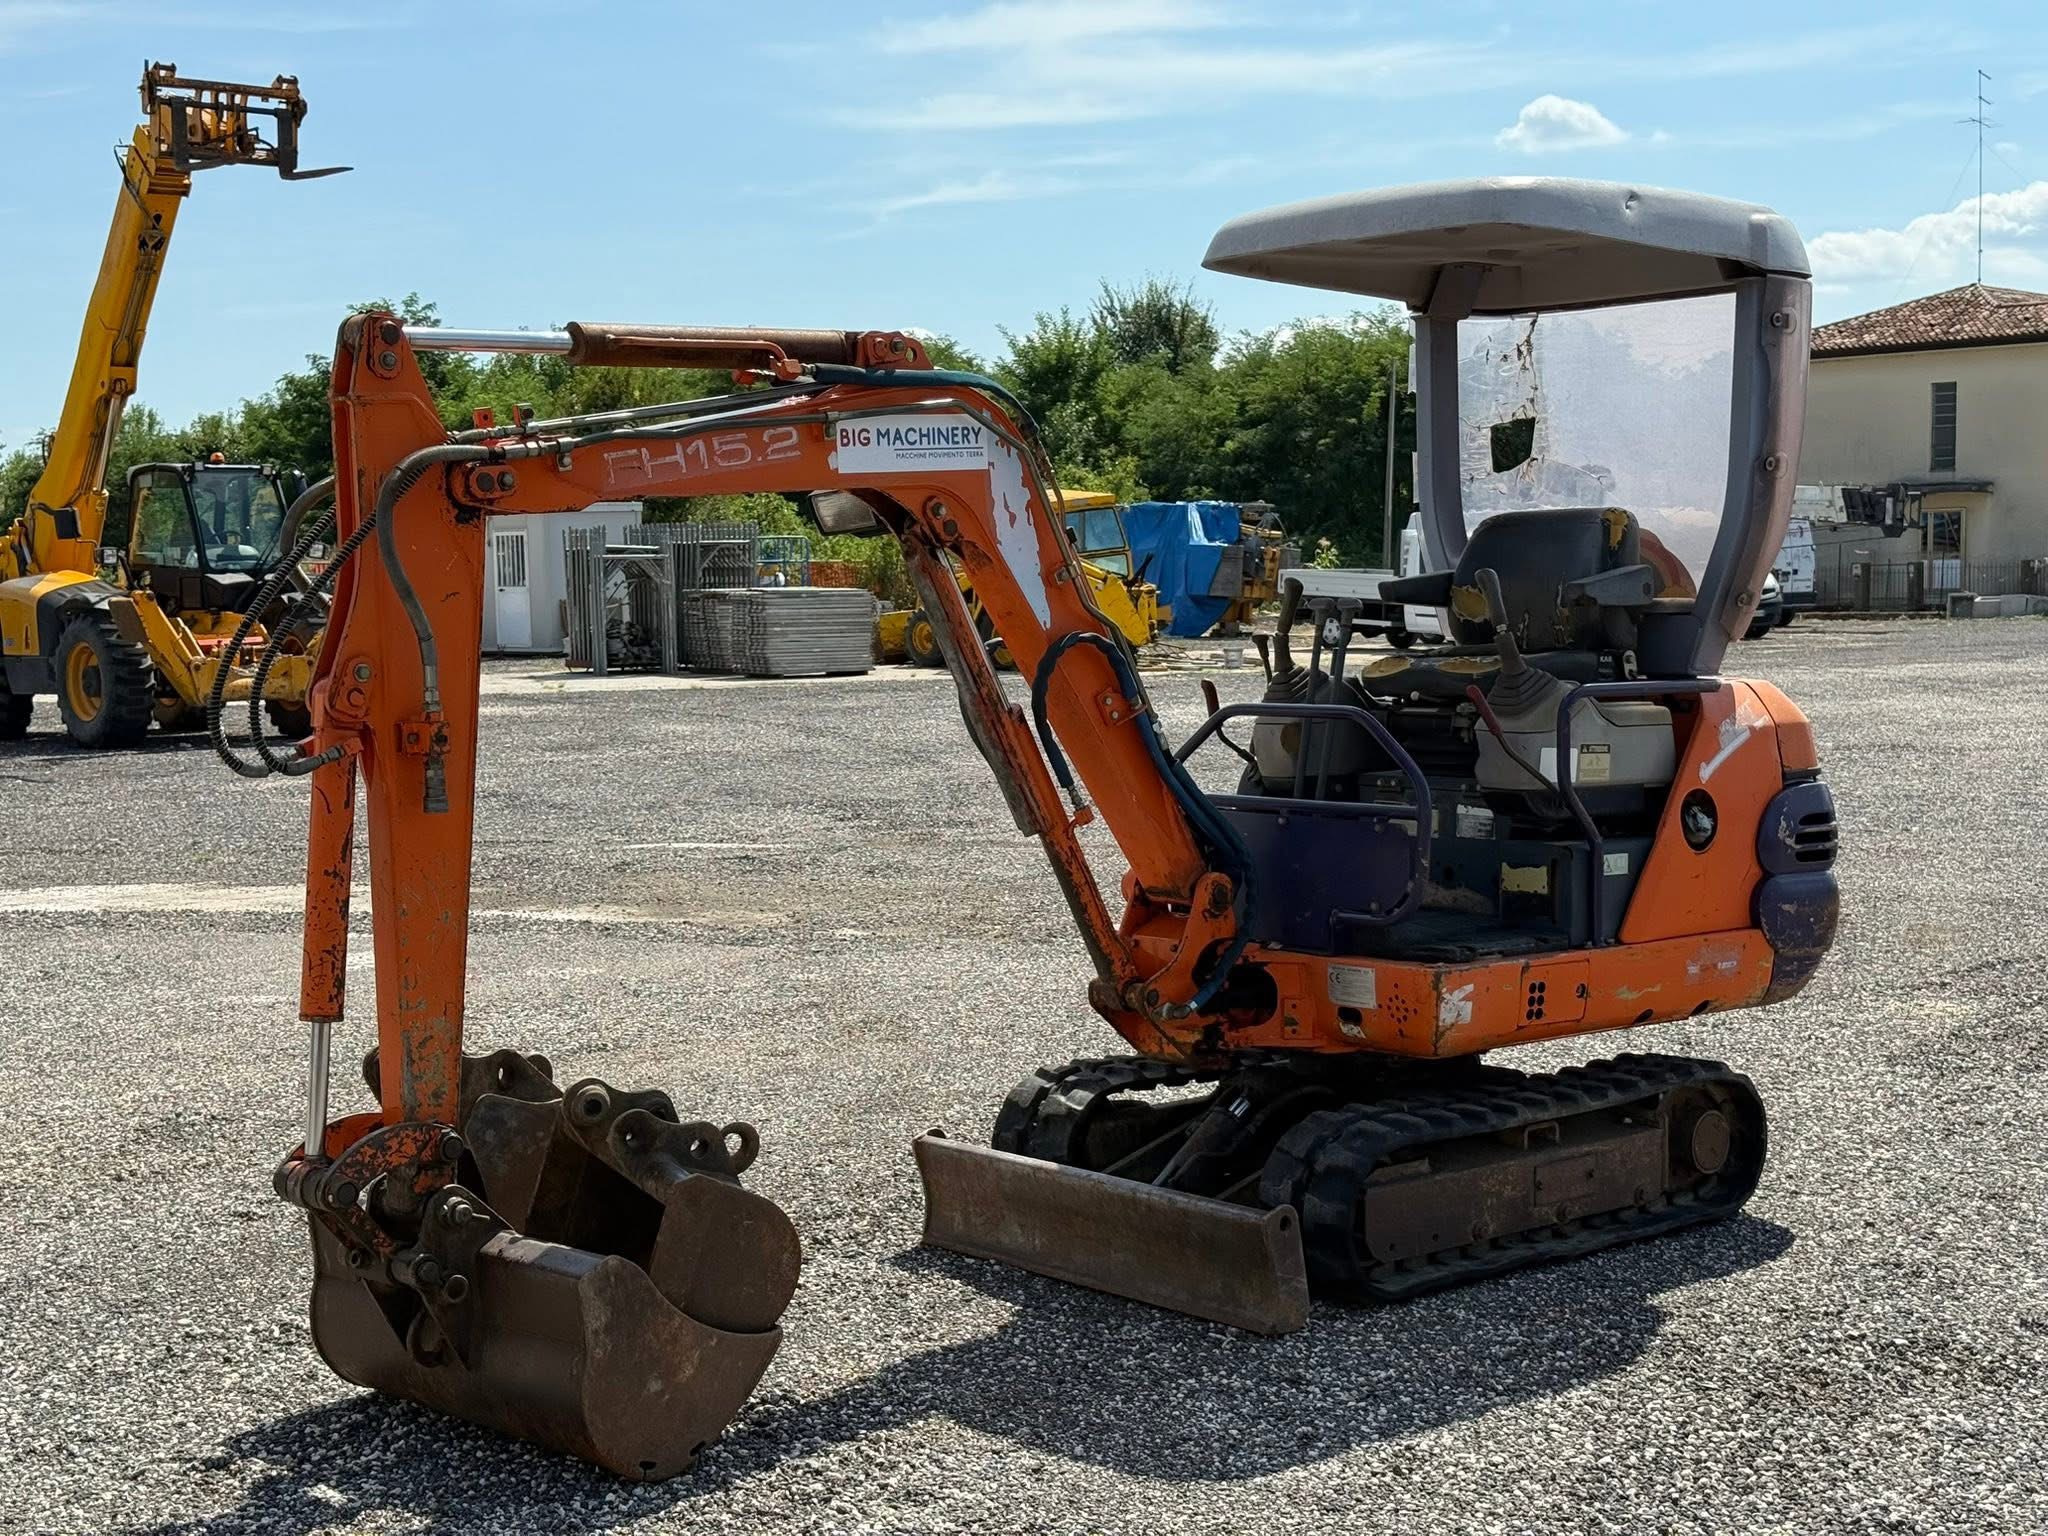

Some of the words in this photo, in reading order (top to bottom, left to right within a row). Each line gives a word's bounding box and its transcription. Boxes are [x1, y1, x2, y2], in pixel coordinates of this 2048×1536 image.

[839, 428, 871, 447] BIG
[876, 426, 982, 447] MACHINERY
[603, 426, 801, 485] FH15.2
[895, 451, 927, 460] MACCHINE
[928, 450, 964, 459] MOVIMENTO
[965, 450, 984, 458] TERRA
